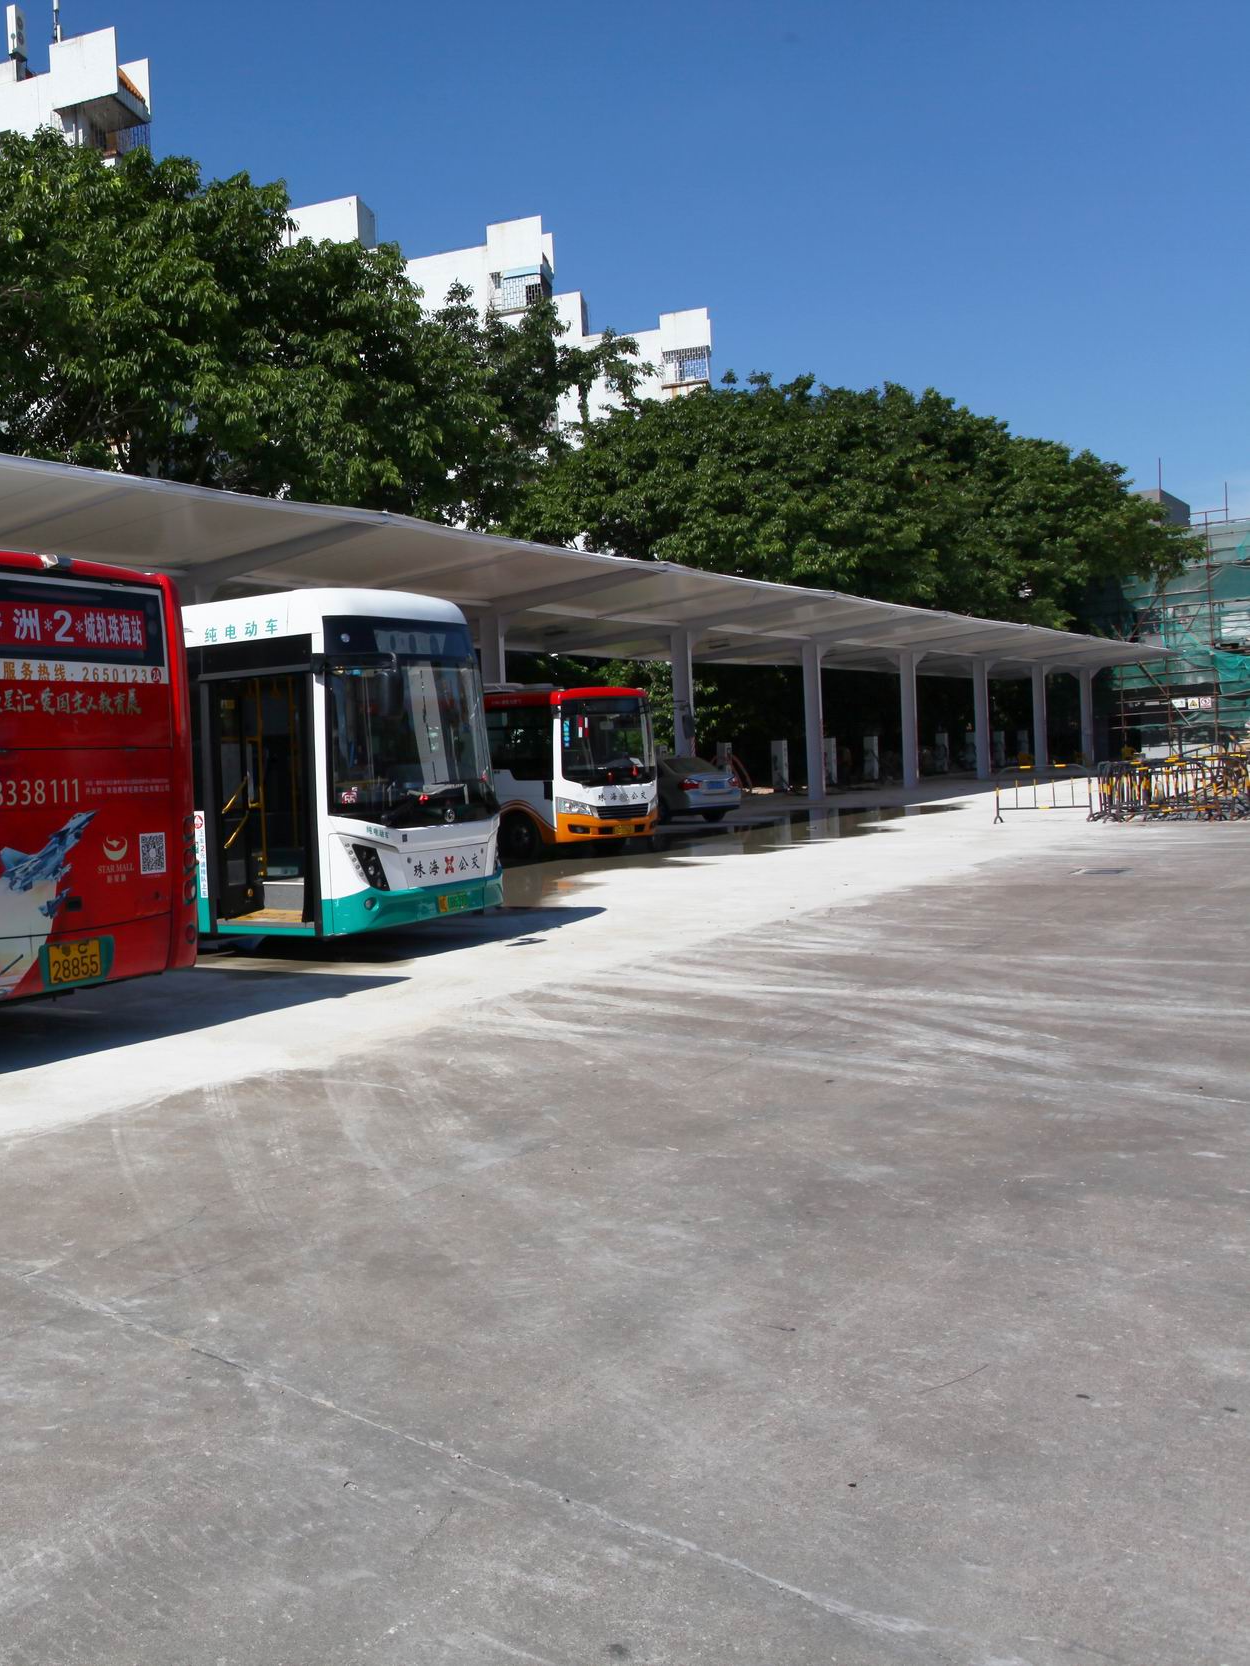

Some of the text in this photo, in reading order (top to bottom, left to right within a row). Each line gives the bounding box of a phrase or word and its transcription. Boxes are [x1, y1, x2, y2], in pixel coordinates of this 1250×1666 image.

[53, 609, 74, 643] 2
[84, 612, 143, 646] 城轨珠海站
[204, 617, 279, 643] 纯电动车
[97, 863, 134, 874] STAR MALL
[413, 852, 480, 878] 珠海 公交
[52, 954, 99, 981] 28855
